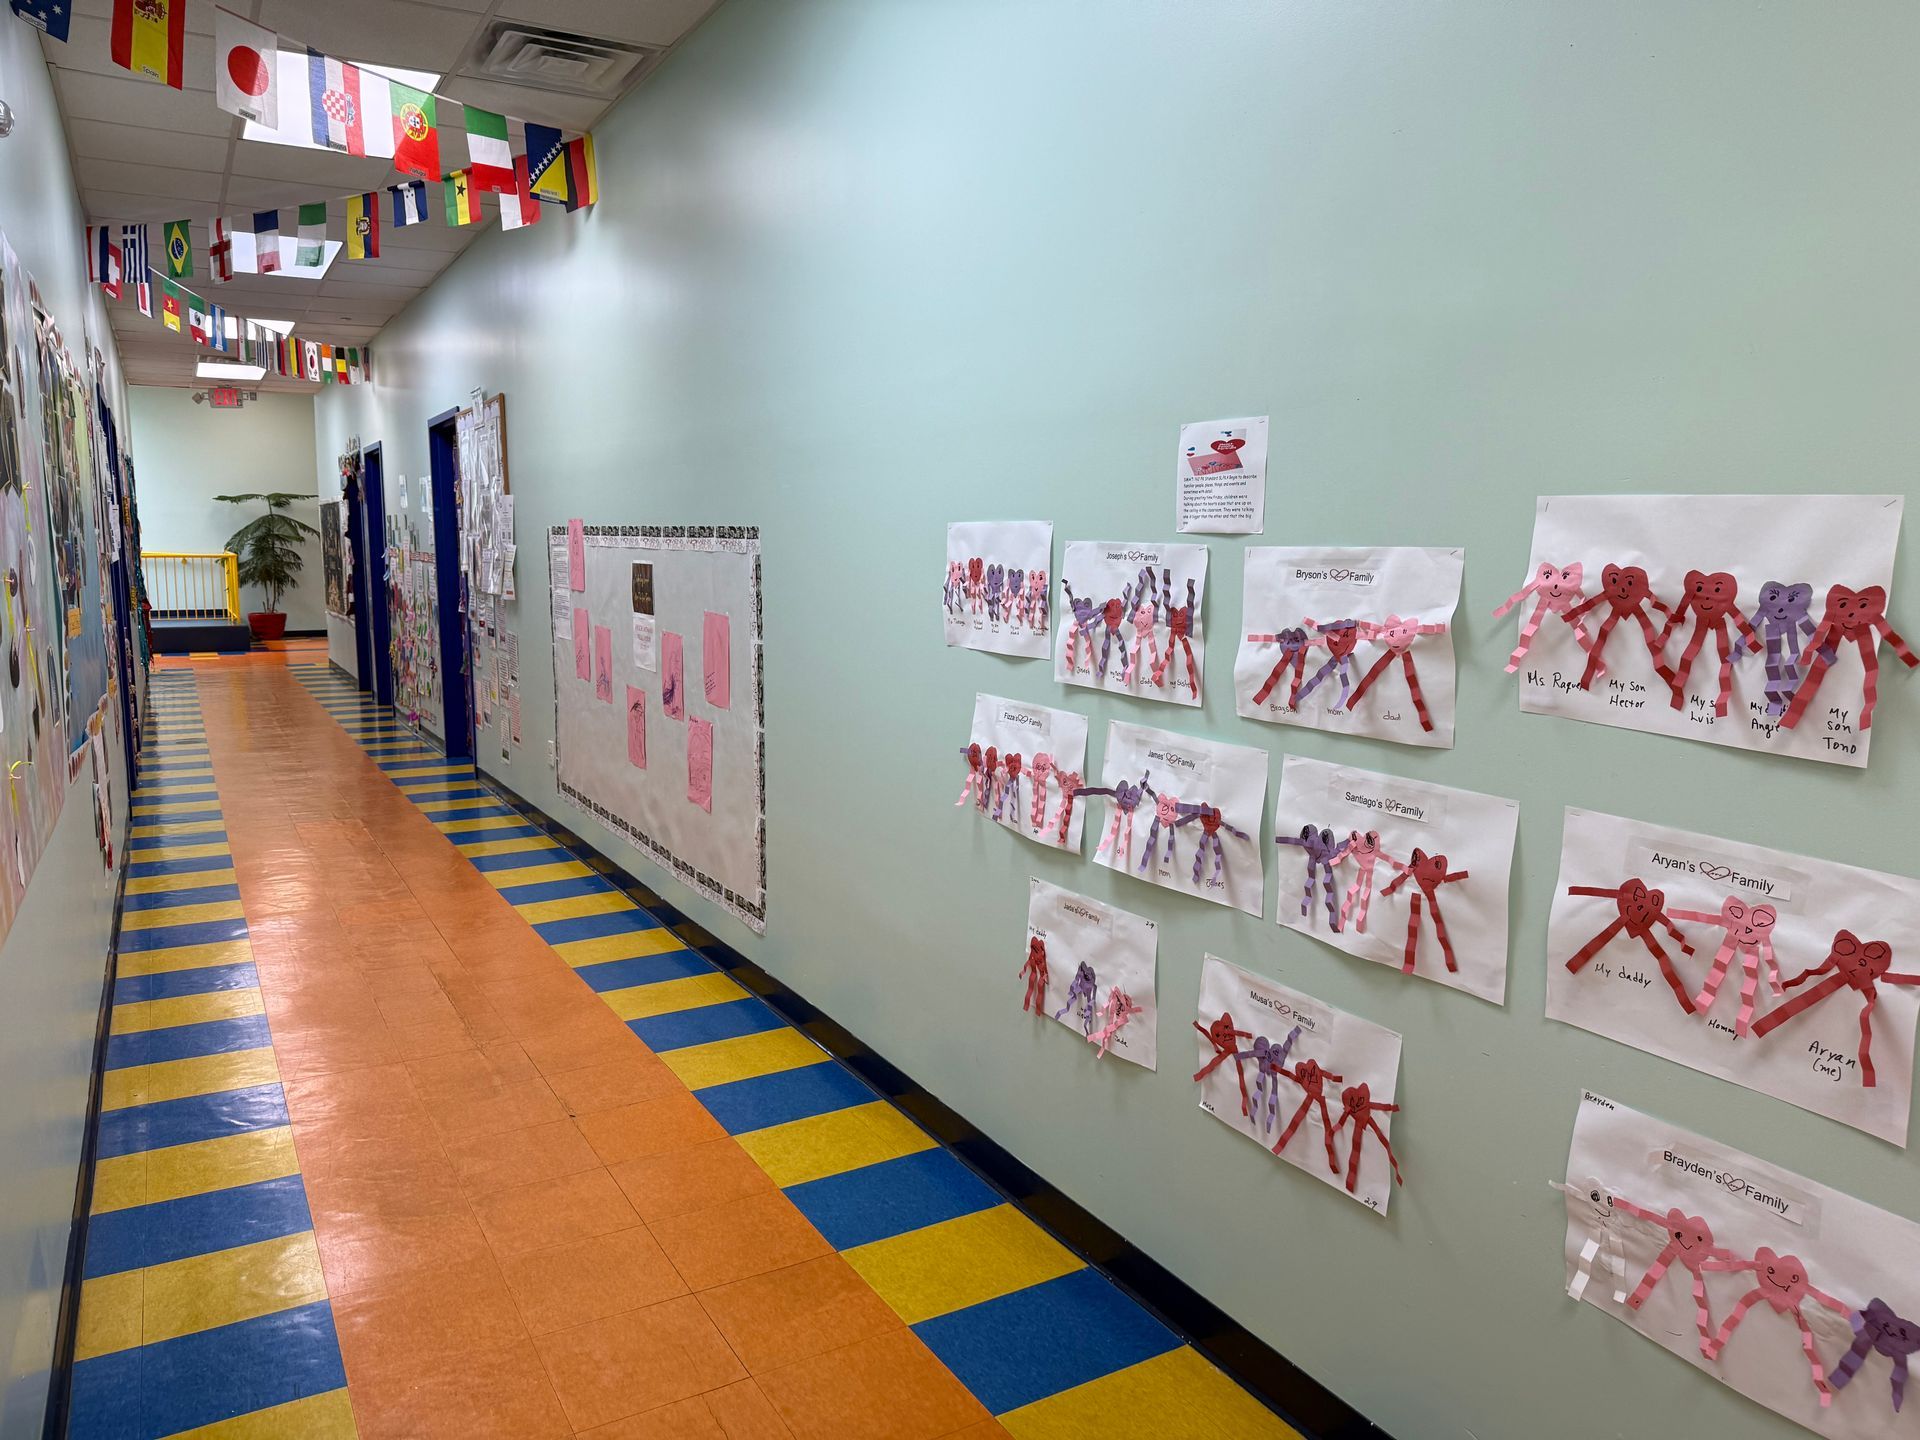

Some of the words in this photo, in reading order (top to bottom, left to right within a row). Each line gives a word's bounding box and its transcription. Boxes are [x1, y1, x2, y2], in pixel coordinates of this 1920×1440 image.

[142, 65, 160, 79] Spain
[215, 388, 238, 406] EXIT
[1106, 552, 1127, 562] Joseph's
[1140, 552, 1158, 564] Family
[1295, 569, 1328, 581] Bryson's
[1349, 571, 1374, 585] Family
[1527, 669, 1546, 687] Ms
[1552, 671, 1582, 694] Raque
[1608, 679, 1625, 692] My
[1609, 694, 1645, 709] Hector
[1690, 694, 1706, 711] My
[1750, 701, 1763, 716] My
[1382, 710, 1401, 721] dad
[1690, 711, 1715, 725] Luis
[1829, 707, 1849, 720] My
[1029, 717, 1043, 729] Family
[1751, 717, 1780, 740] Angie
[1822, 736, 1857, 755] Tono
[1147, 750, 1166, 761] James'
[1177, 756, 1196, 770] Family
[1345, 791, 1383, 809] Santiago's
[1395, 803, 1424, 819] Family
[1651, 852, 1696, 874] Aryan's
[1730, 871, 1775, 895] Family
[1085, 911, 1100, 925] Family
[1594, 962, 1611, 976] My
[1618, 966, 1652, 989] daddy
[1250, 990, 1273, 1009] Musa's
[1292, 1010, 1316, 1029] Family
[1808, 1040, 1857, 1070] Aryan
[1812, 1056, 1842, 1082] (me)
[1584, 1091, 1615, 1111] Brayden
[1663, 1150, 1723, 1185] Brayden's
[1744, 1186, 1789, 1215] Family
